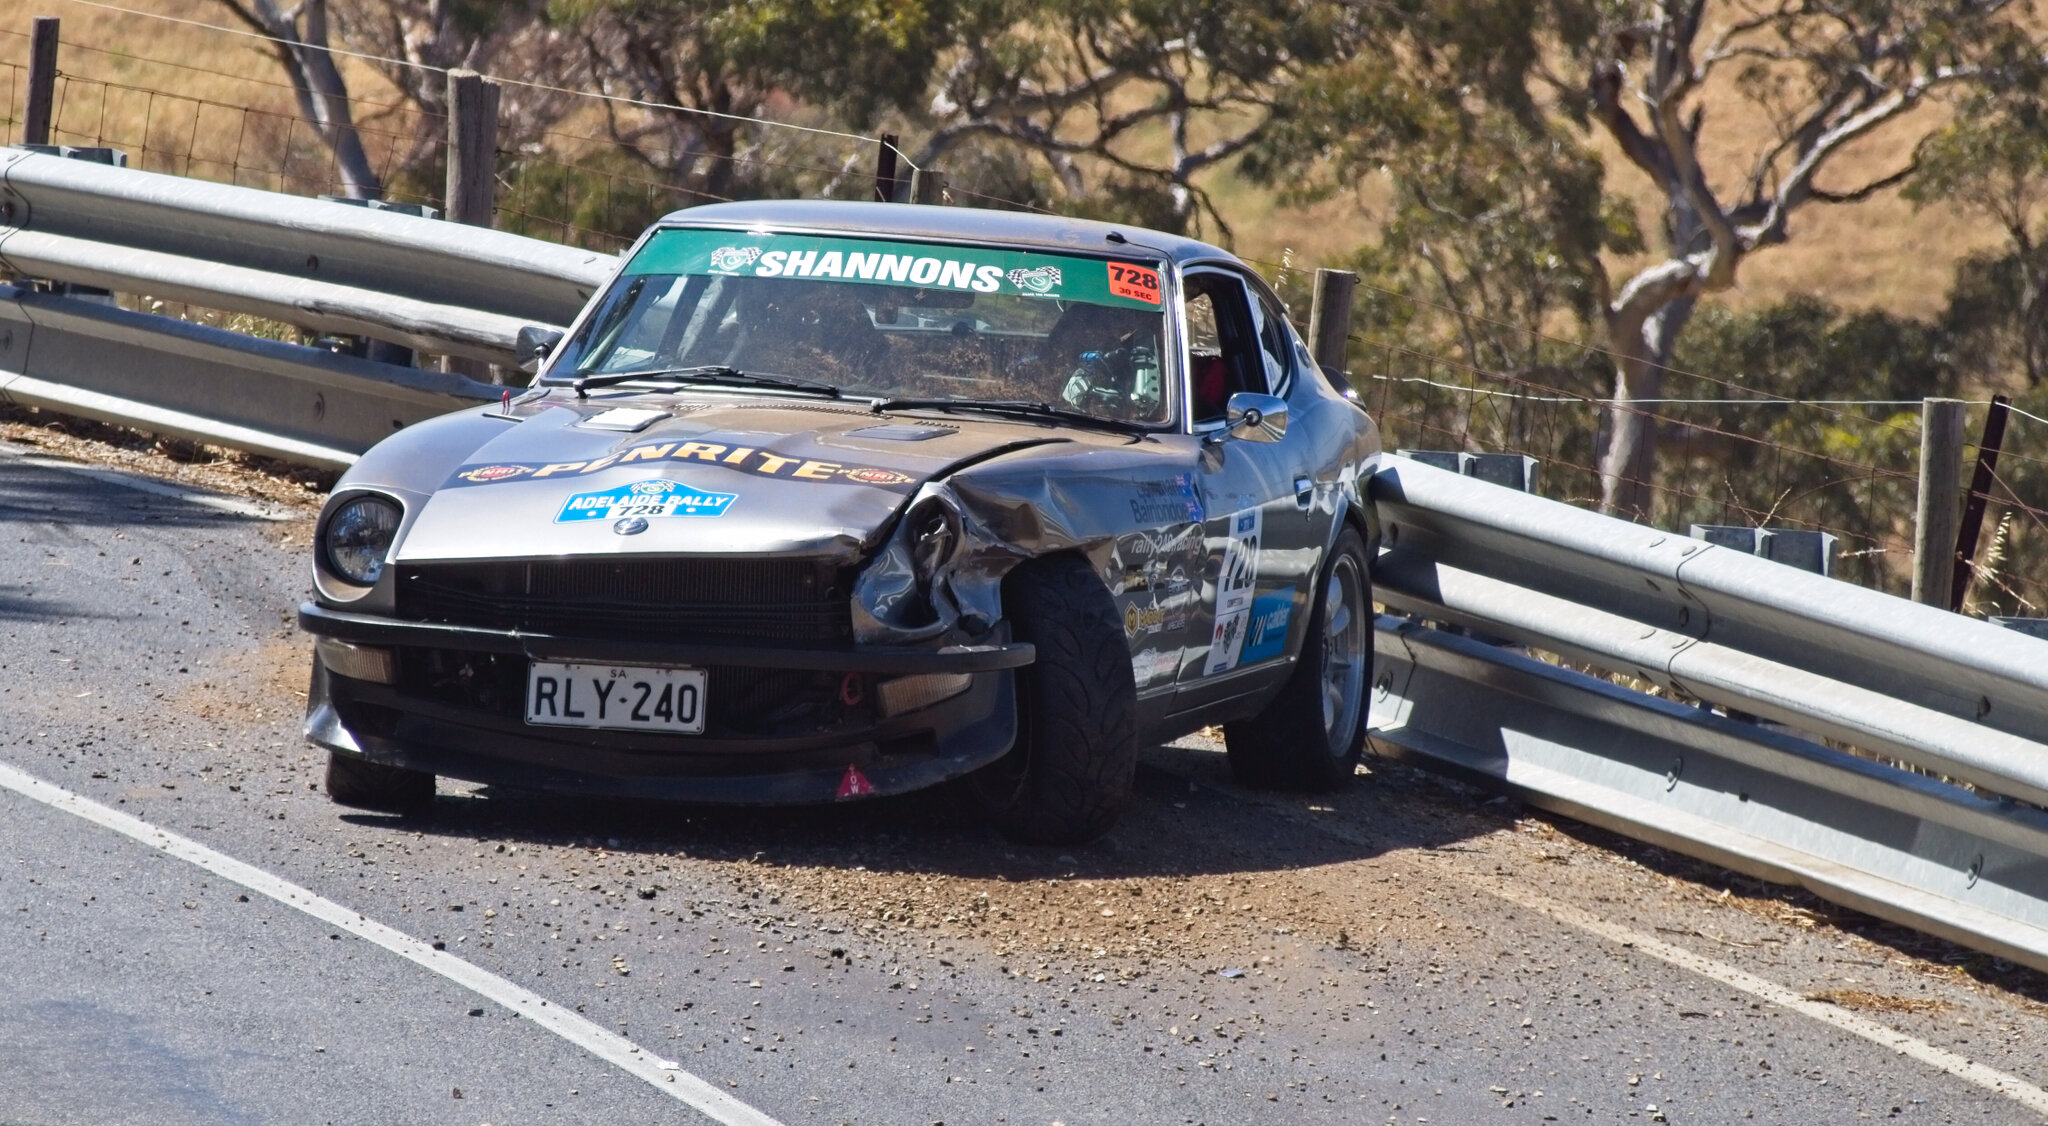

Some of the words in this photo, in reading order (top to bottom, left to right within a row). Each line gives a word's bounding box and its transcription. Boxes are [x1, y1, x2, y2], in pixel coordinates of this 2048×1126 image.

[755, 250, 1004, 293] SHANNONS
[1109, 265, 1158, 290] 728
[1119, 287, 1131, 296] 30
[1134, 291, 1152, 301] SEC
[530, 441, 842, 480] PENRITE
[568, 494, 663, 510] ADELAIDE
[665, 494, 729, 507] RALLY
[618, 505, 665, 517] 728
[610, 669, 627, 678] SA
